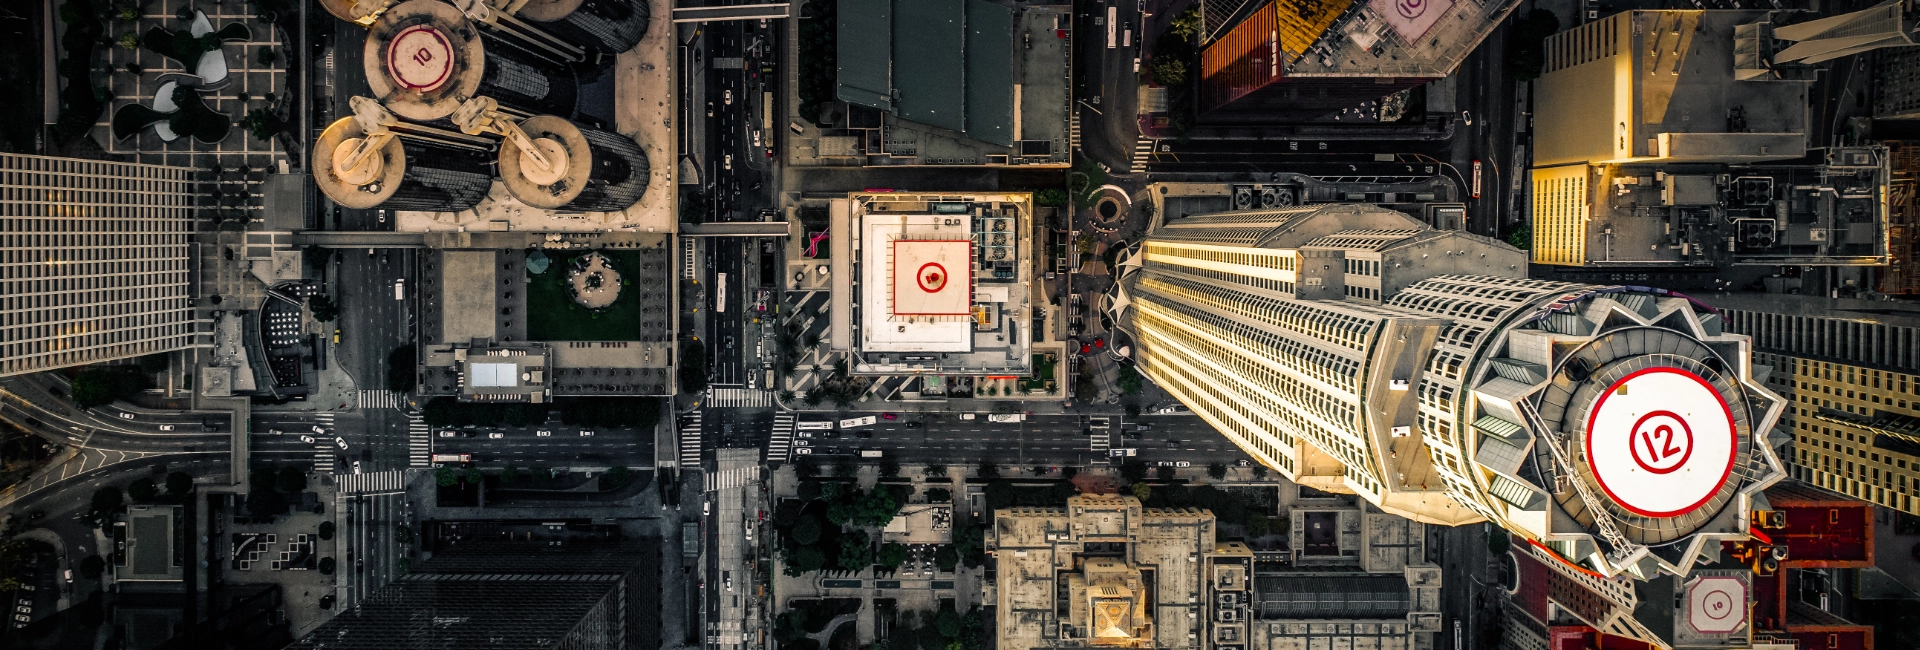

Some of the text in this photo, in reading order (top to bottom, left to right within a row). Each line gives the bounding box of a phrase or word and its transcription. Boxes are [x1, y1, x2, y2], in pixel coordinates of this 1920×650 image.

[413, 47, 432, 67] 10
[1641, 424, 1681, 463] 12
[1712, 601, 1724, 611] 10
